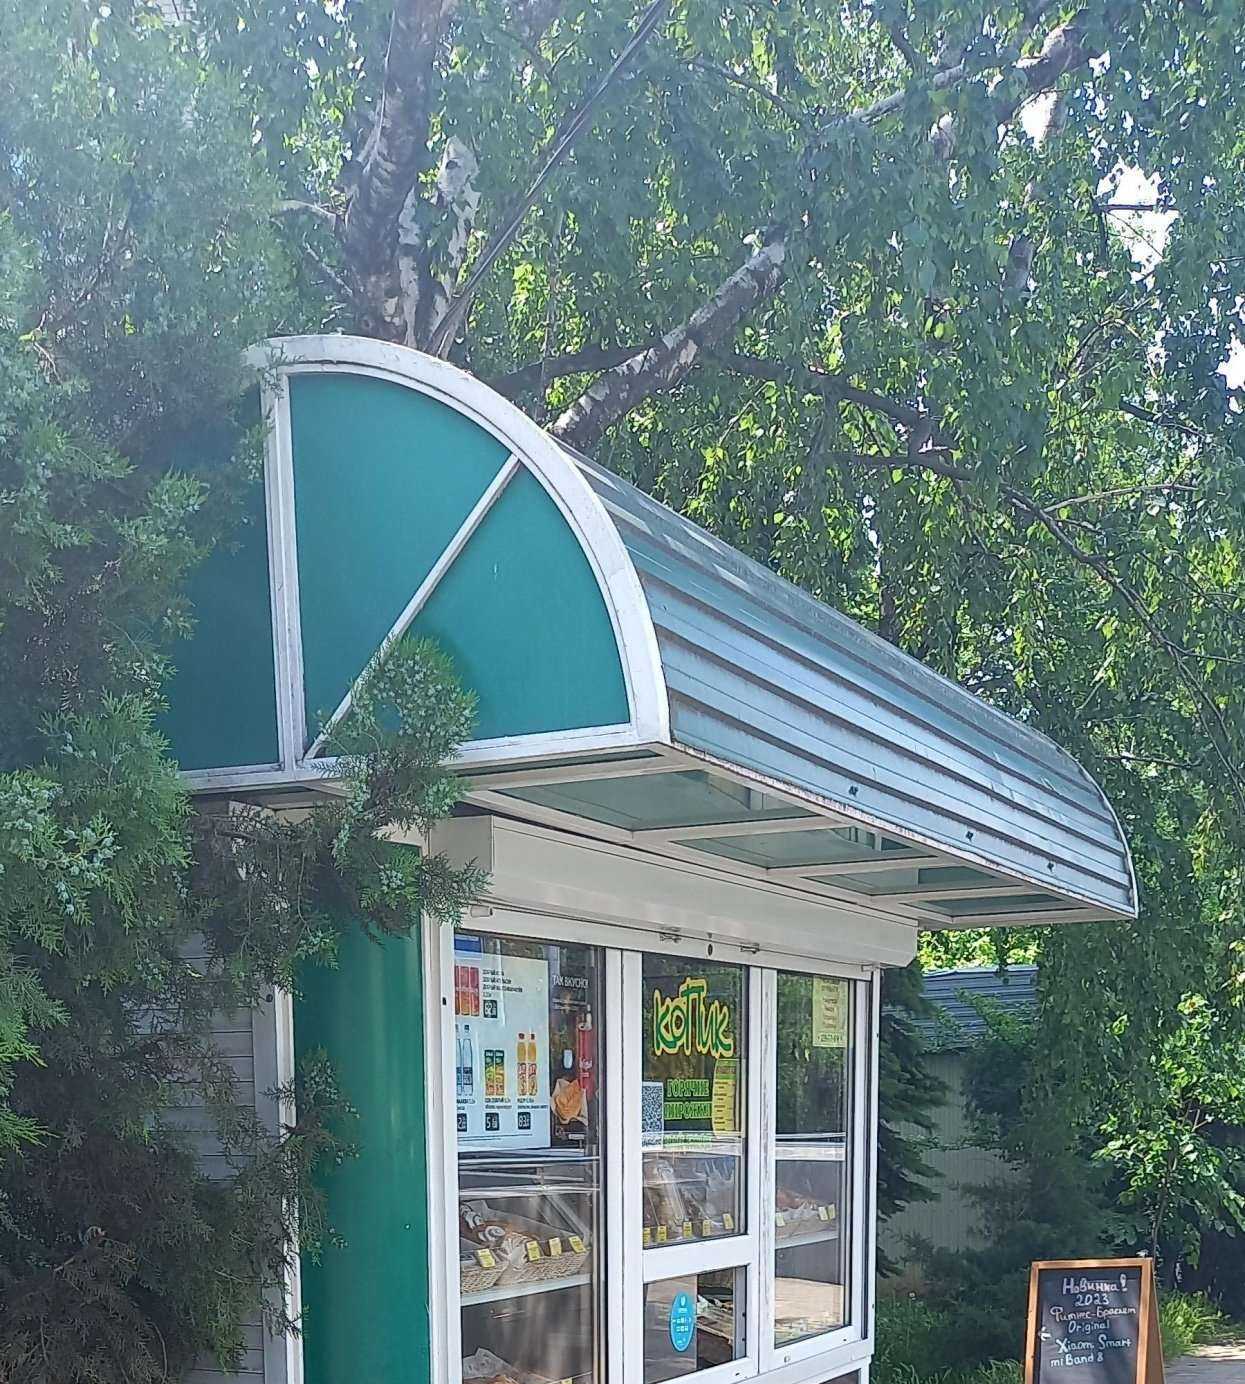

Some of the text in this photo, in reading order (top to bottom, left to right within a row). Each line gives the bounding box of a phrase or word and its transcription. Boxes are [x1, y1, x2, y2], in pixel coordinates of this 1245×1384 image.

[667, 1078, 710, 1097] ГОРЯЧИЕ
[1062, 1273, 1128, 1295] Новинка!
[1074, 1293, 1110, 1306] 2023
[1068, 1319, 1110, 1334] Original
[1098, 1334, 1132, 1350] Smart
[1065, 1352, 1094, 1366] Band
[1096, 1351, 1104, 1362] 8
